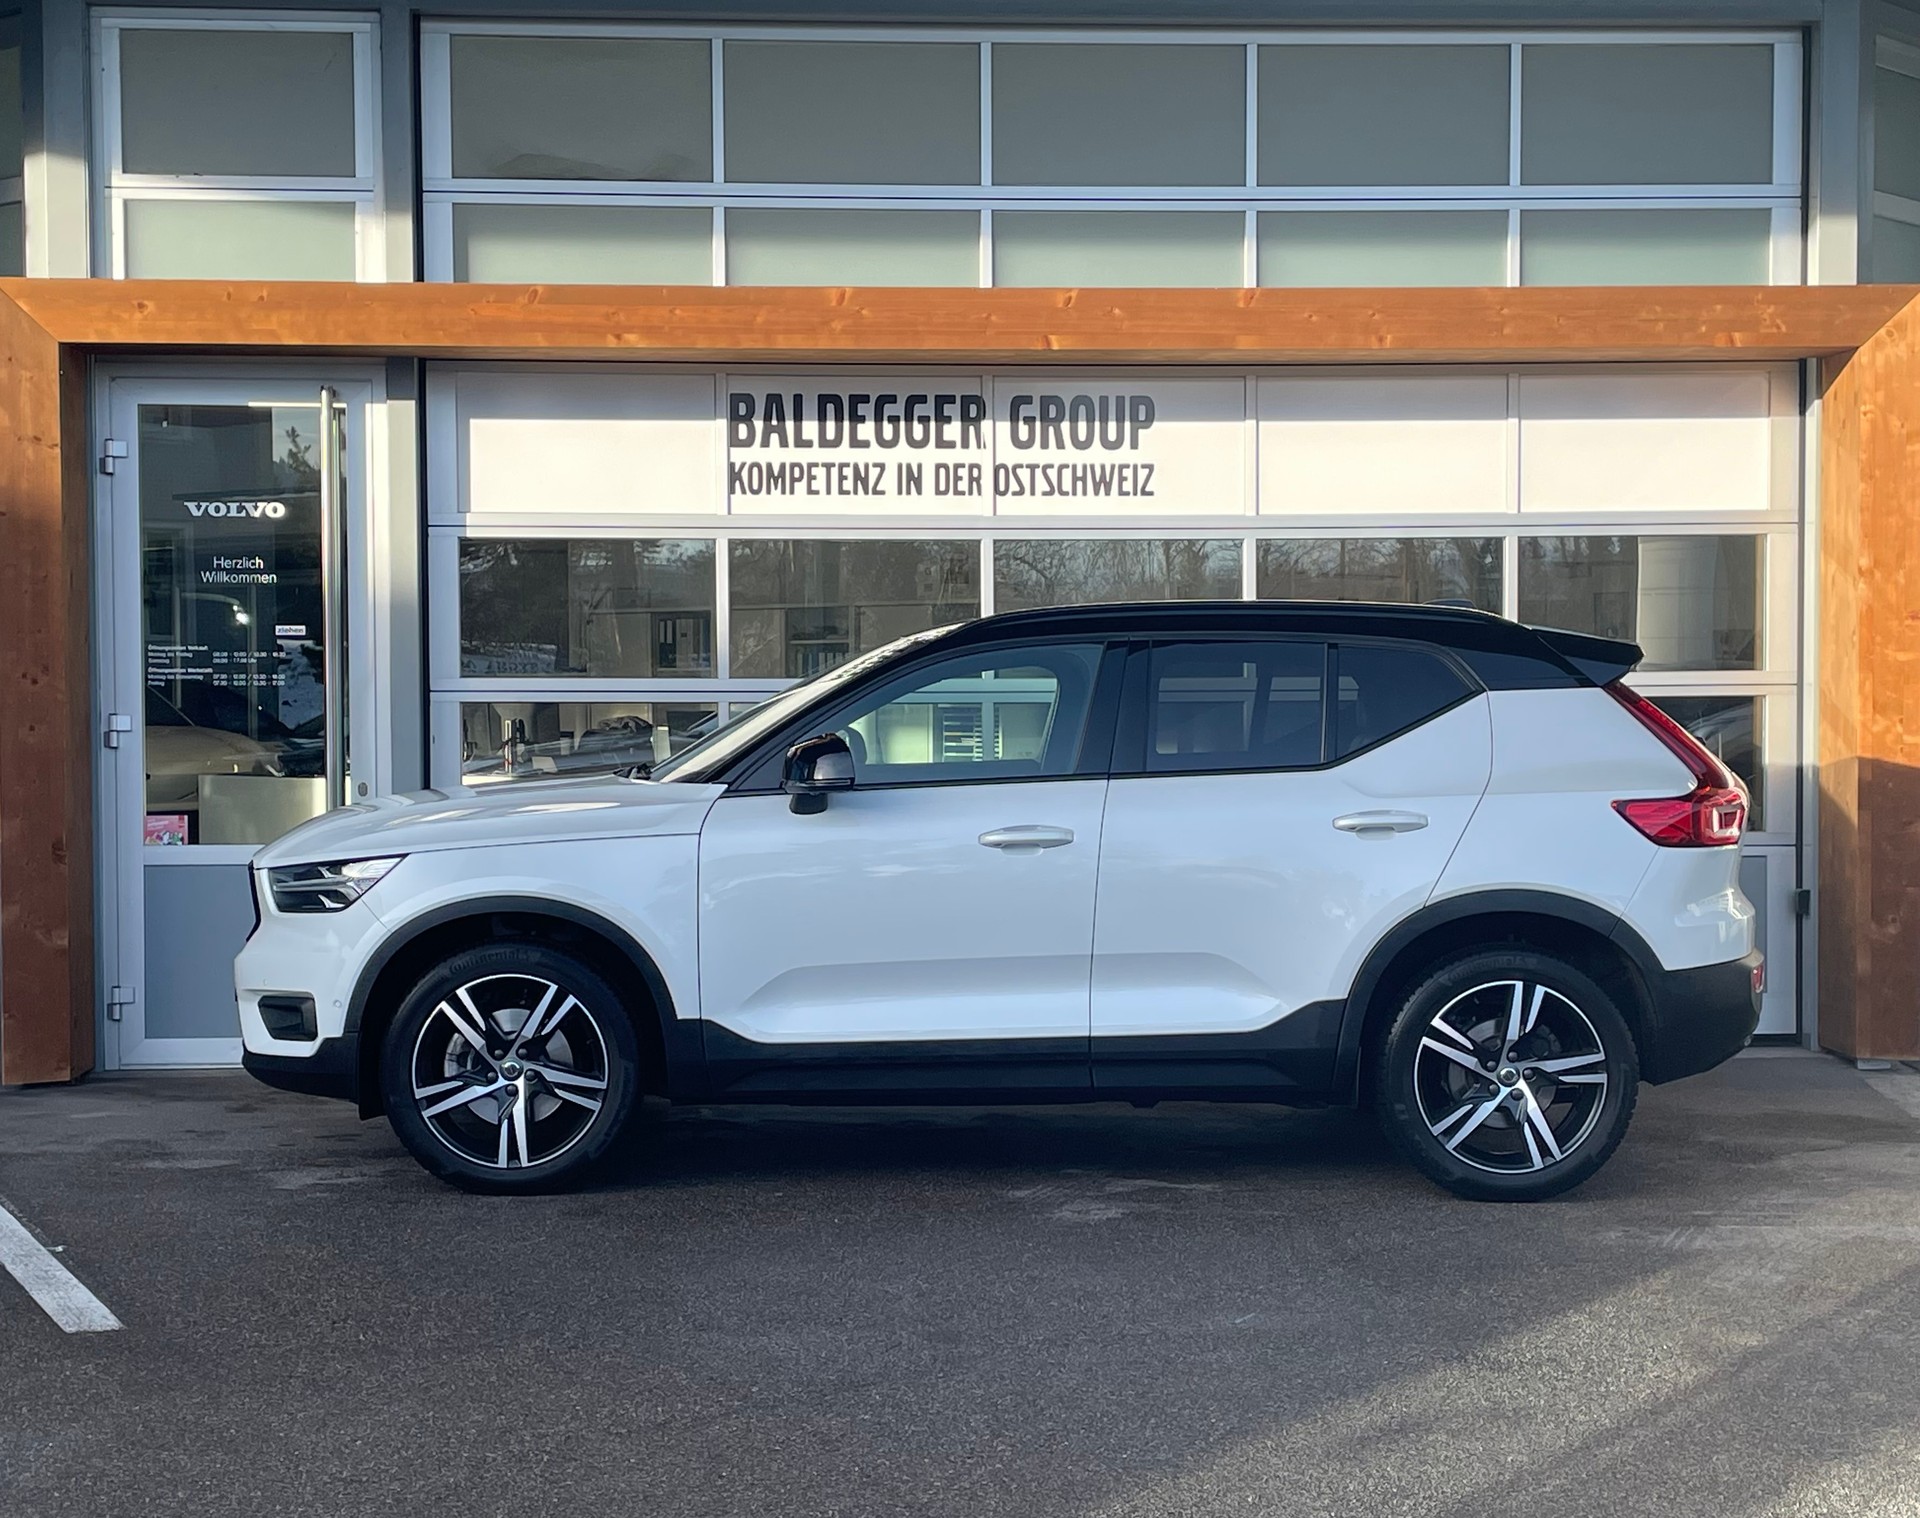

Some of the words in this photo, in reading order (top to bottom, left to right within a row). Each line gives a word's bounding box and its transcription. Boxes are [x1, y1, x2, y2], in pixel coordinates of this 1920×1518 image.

[728, 392, 987, 450] BALDEGGER
[1009, 394, 1156, 451] GROUP
[729, 461, 886, 496] KOMPETENZ
[897, 462, 924, 496] IN
[934, 462, 982, 497] DER
[995, 463, 1156, 497] OSTSCHWEIZ
[184, 501, 286, 518] VOLVO
[213, 556, 264, 569] Herzlich
[200, 571, 277, 584] Willkommen
